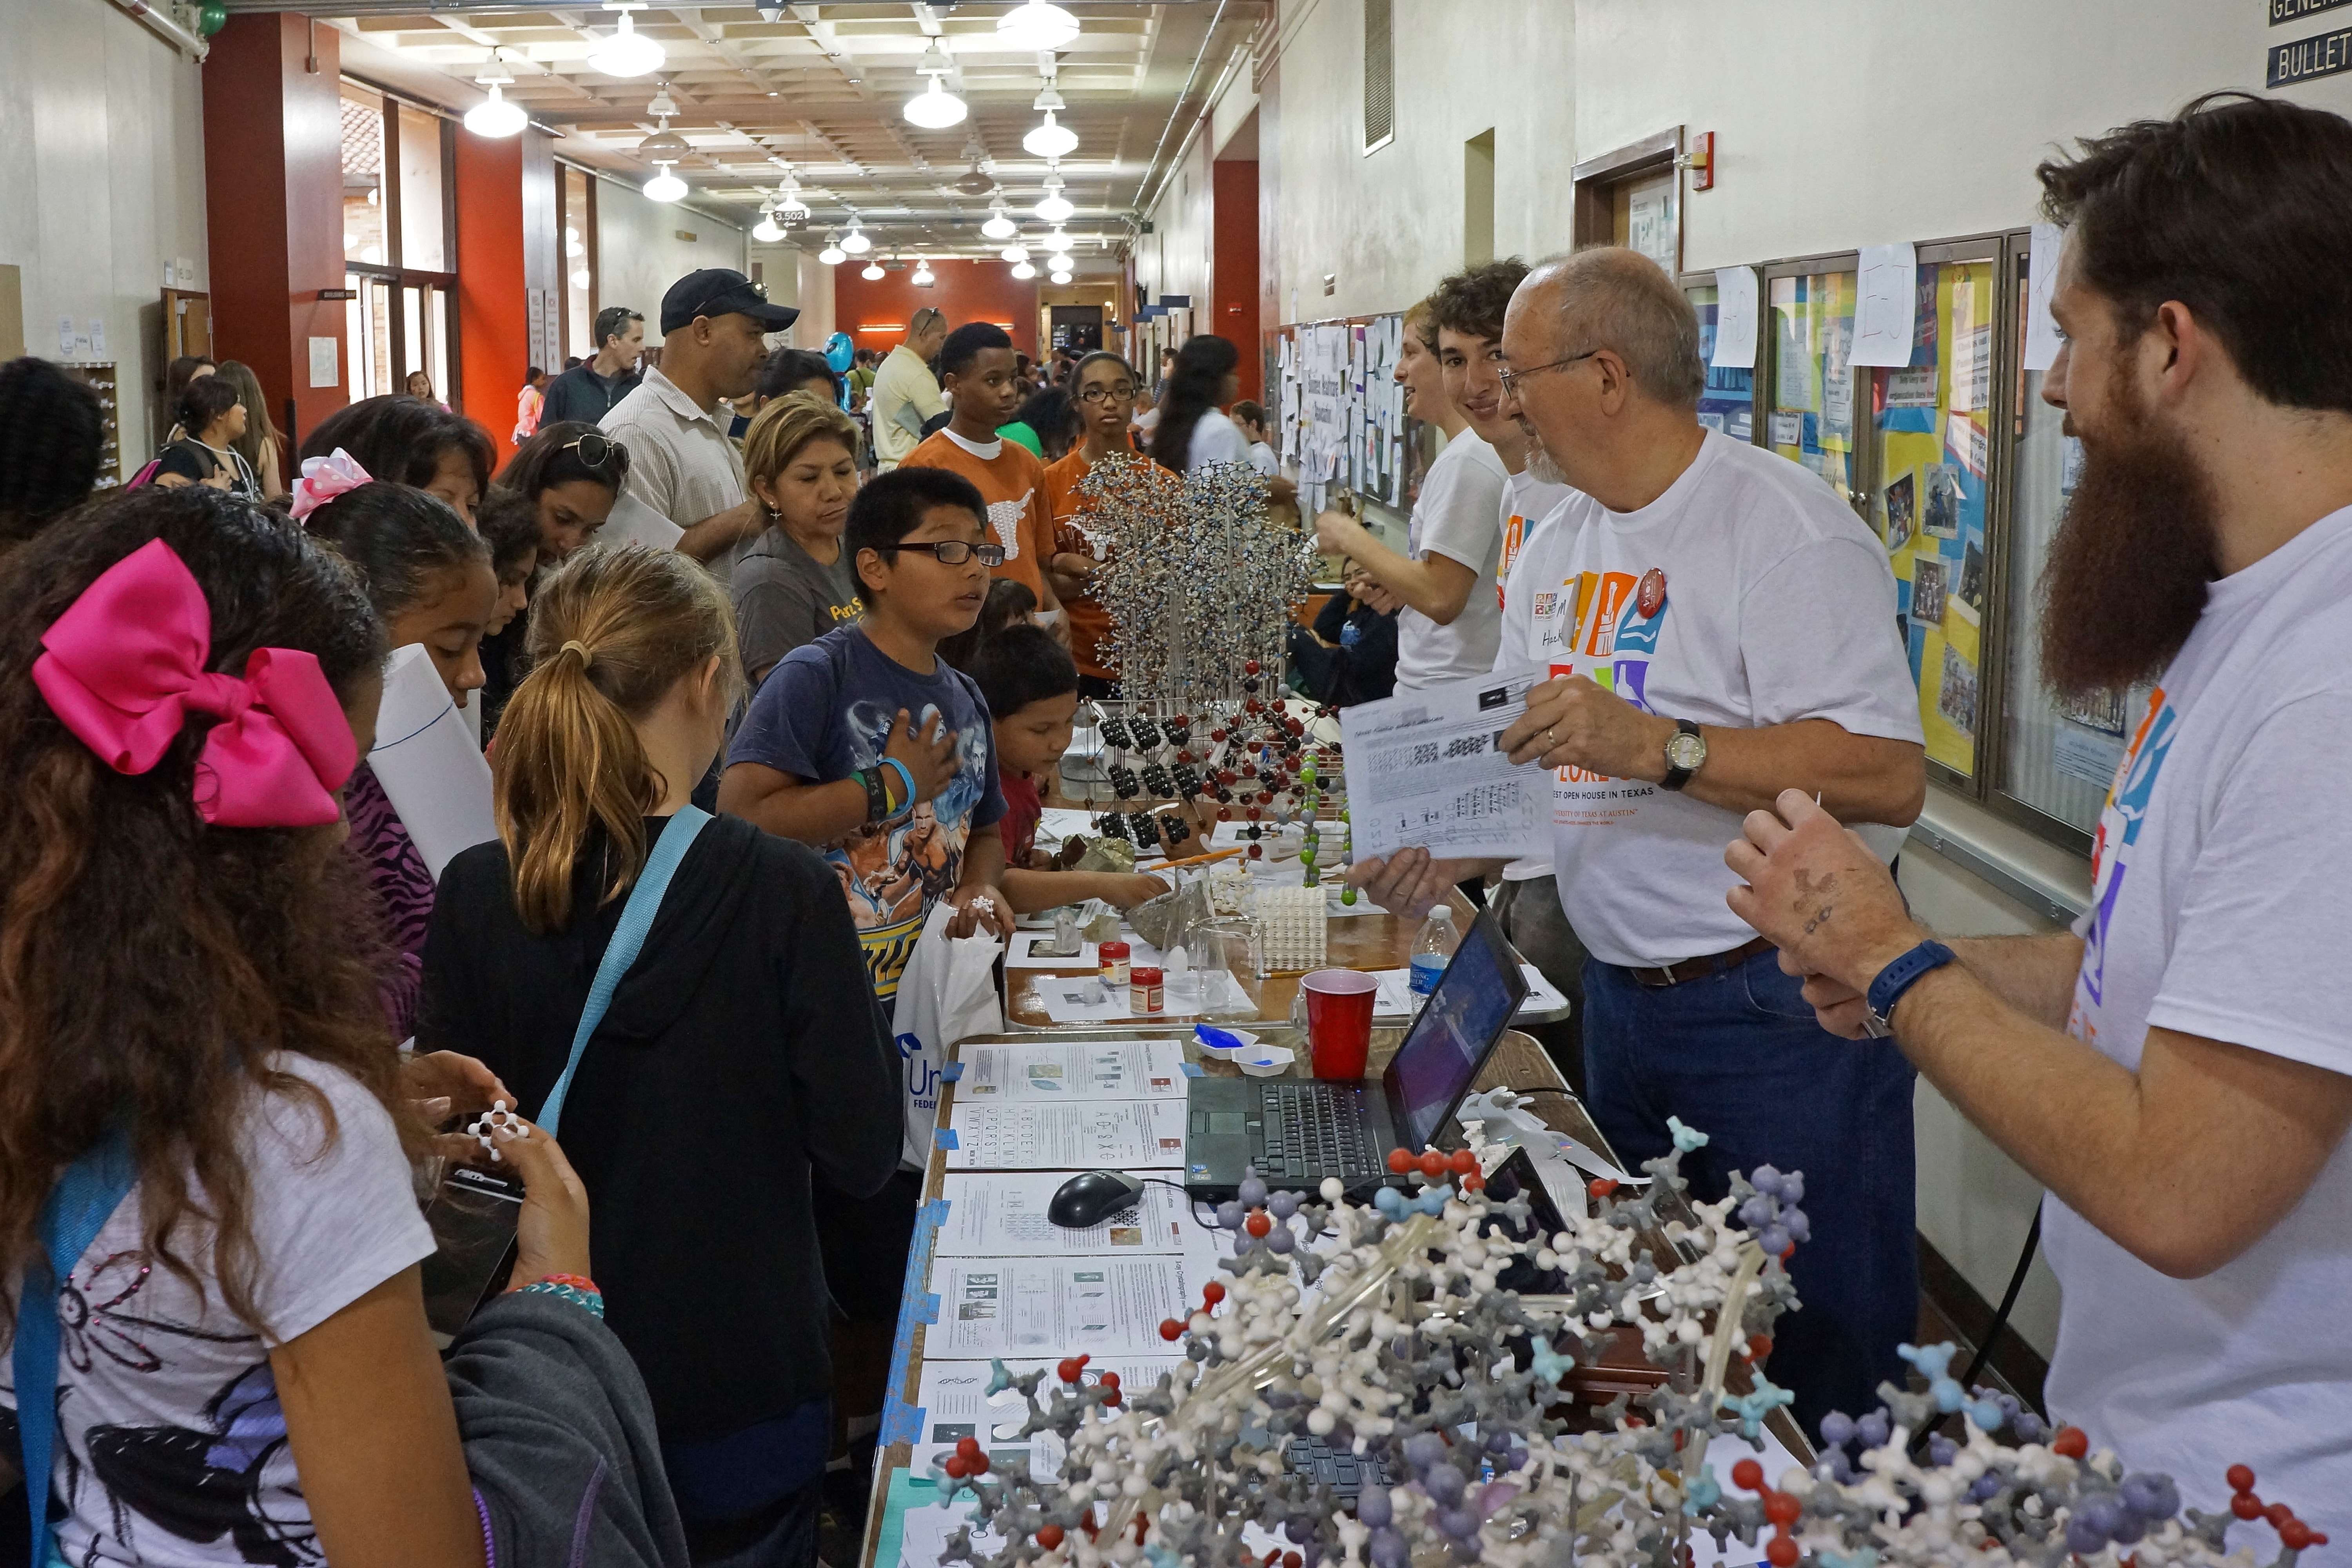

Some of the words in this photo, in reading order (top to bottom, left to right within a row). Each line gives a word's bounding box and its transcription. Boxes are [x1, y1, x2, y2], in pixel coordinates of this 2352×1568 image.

[776, 212, 804, 221] 3.502
[1582, 791, 1606, 799] HOUSE
[1609, 790, 1618, 799] IN
[1621, 787, 1654, 798] TEXAS
